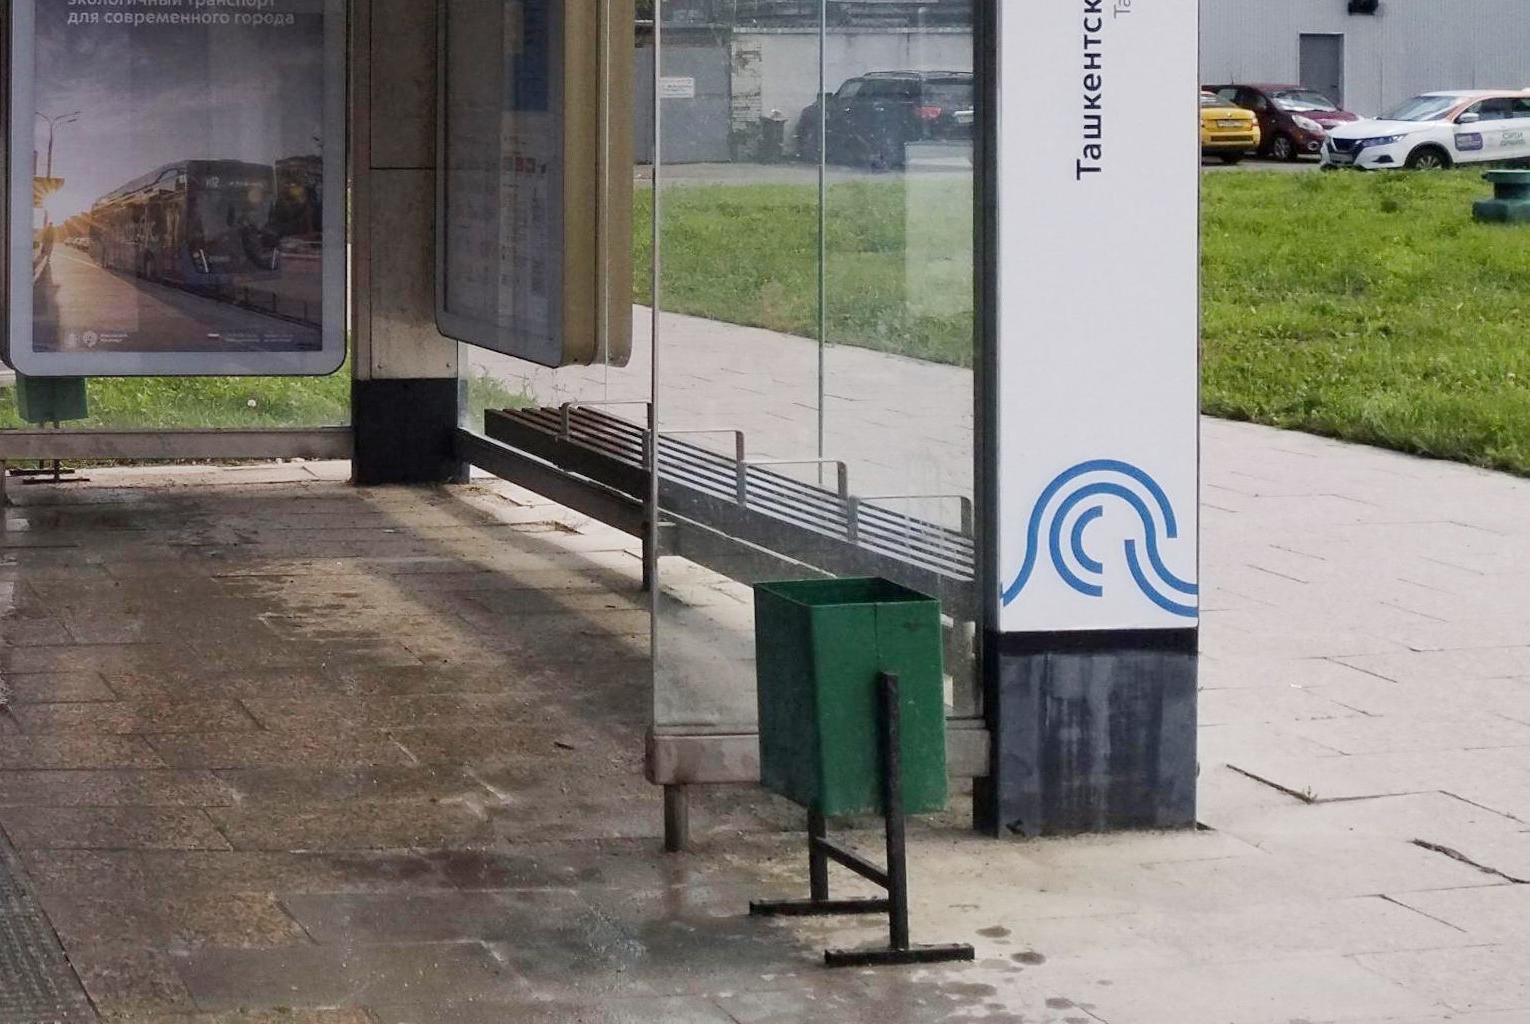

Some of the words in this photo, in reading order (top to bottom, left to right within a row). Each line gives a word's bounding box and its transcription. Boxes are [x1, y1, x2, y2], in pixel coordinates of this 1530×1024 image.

[67, 11, 100, 25] для
[105, 10, 231, 26] современного
[234, 12, 295, 26] города
